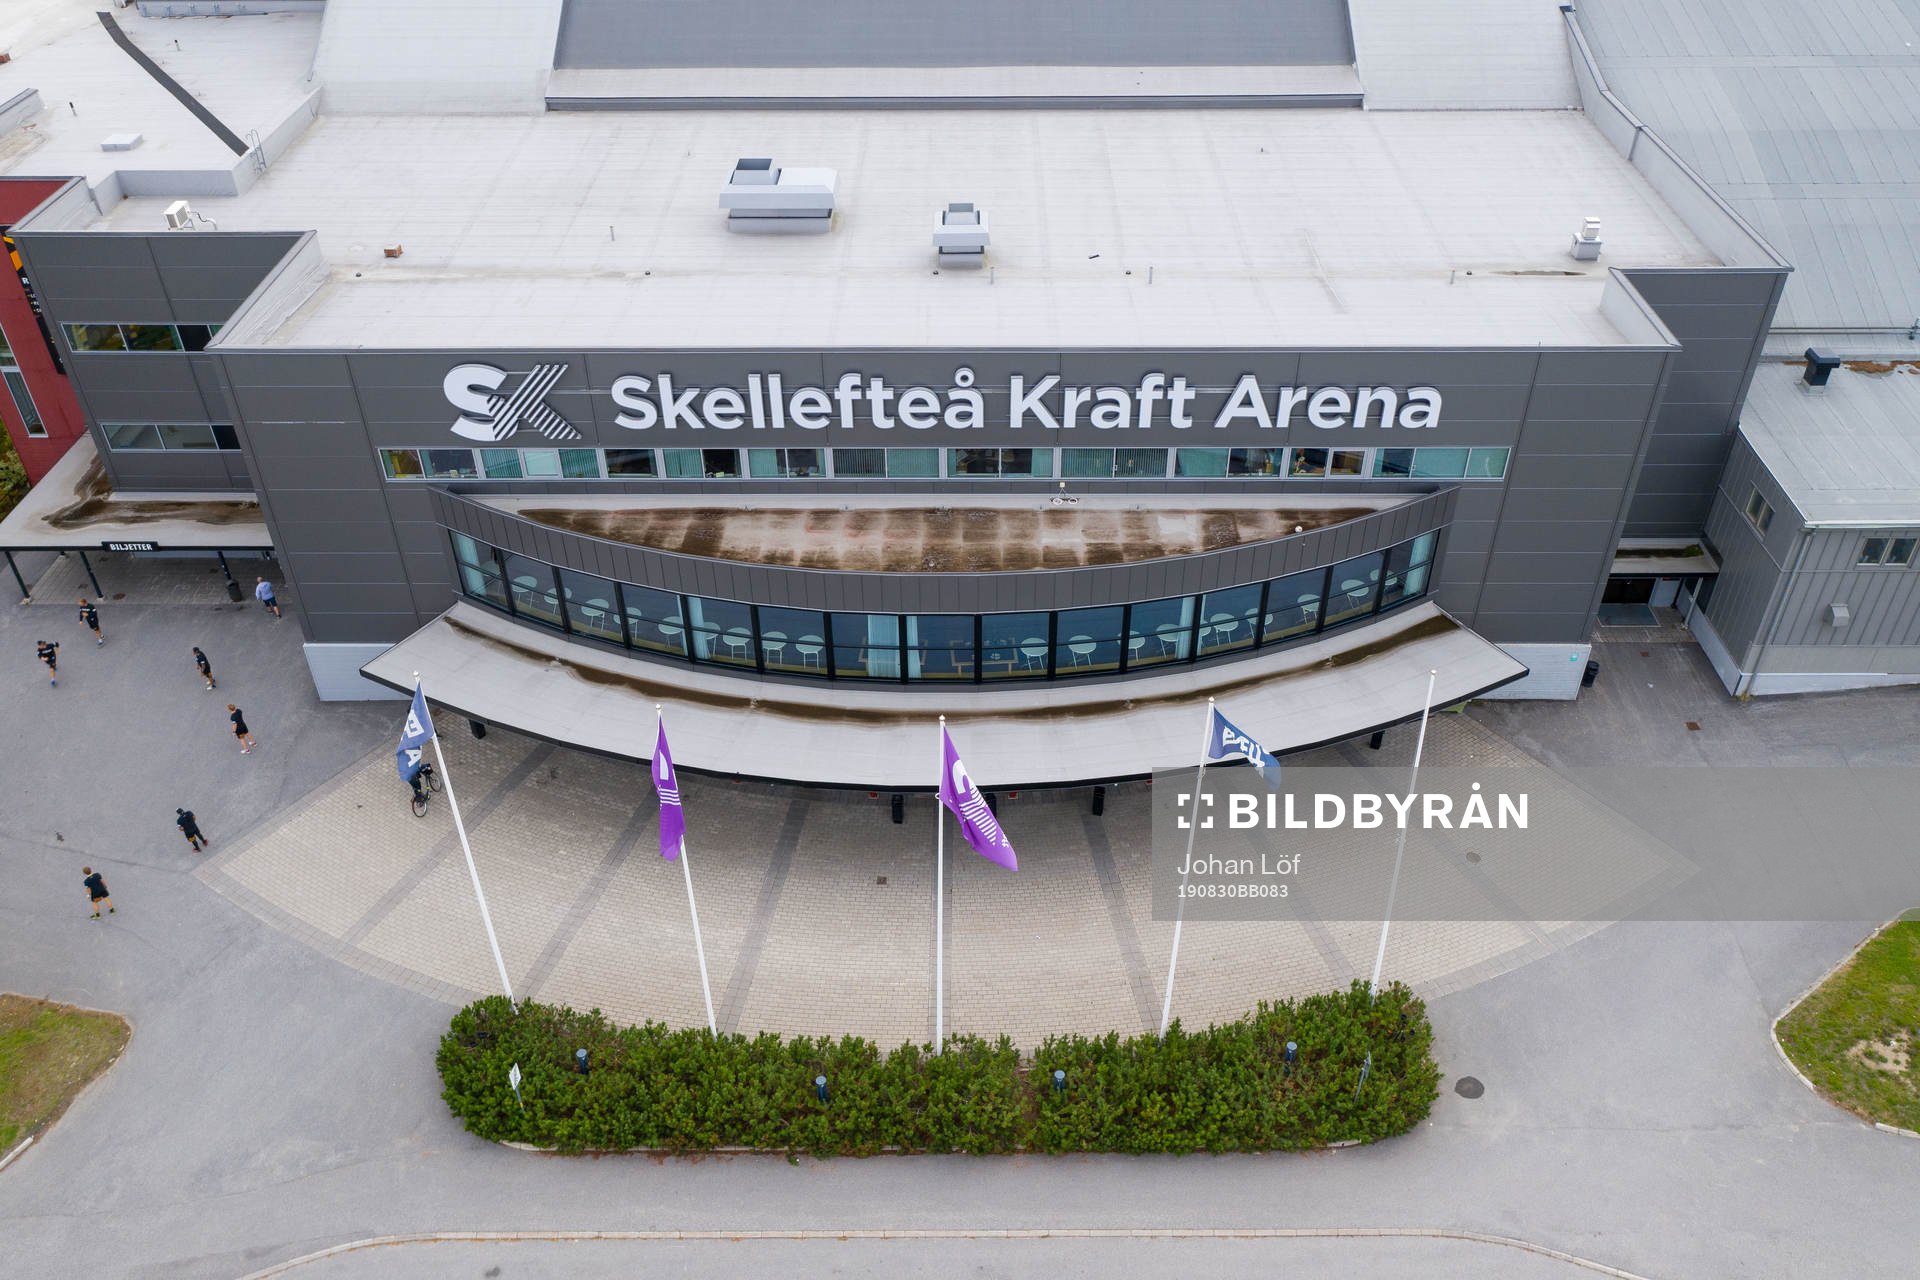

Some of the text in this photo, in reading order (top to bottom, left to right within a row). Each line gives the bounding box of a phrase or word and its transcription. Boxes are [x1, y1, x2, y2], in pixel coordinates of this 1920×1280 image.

[611, 367, 1443, 429] Skellefteå Kraft Arena
[109, 543, 153, 551] BILJETTER
